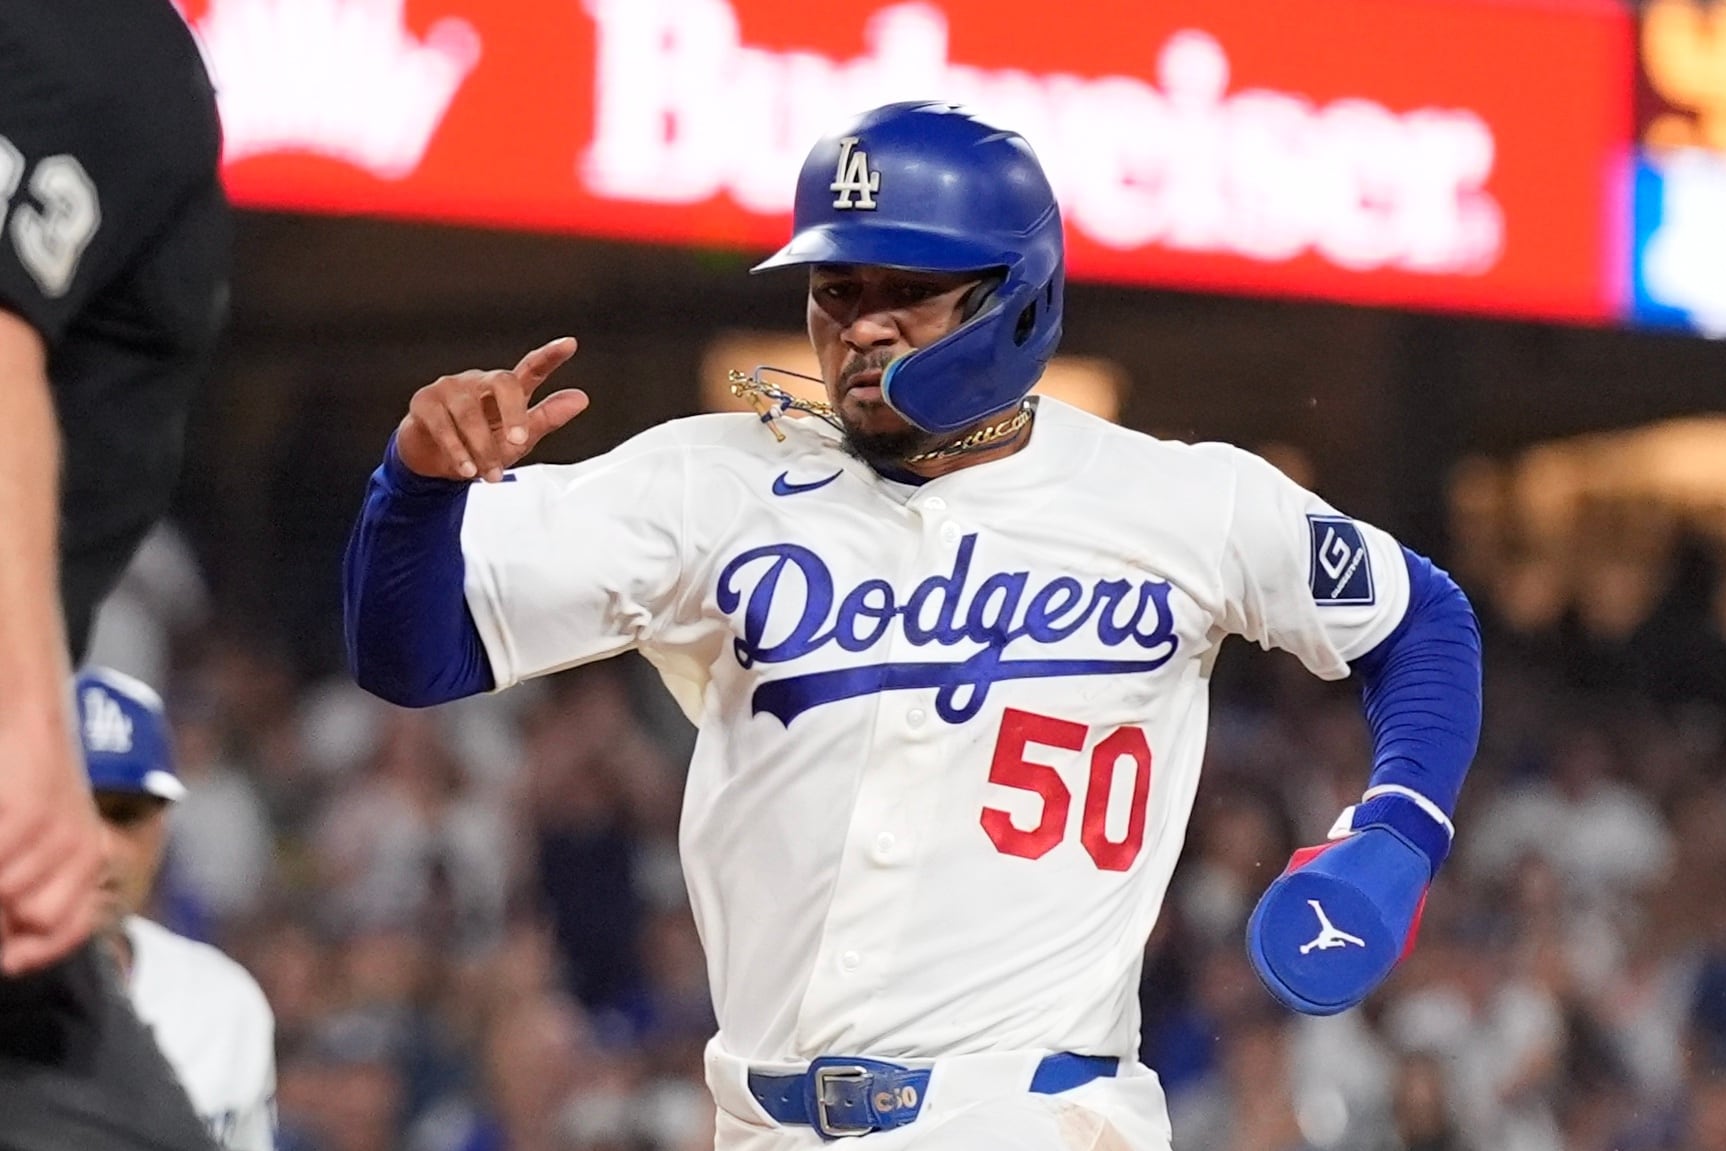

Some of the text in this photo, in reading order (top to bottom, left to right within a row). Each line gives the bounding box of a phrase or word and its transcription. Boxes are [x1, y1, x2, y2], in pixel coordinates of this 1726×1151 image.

[829, 136, 880, 209] LA
[717, 533, 1179, 725] Dodgers
[979, 706, 1152, 872] 50
